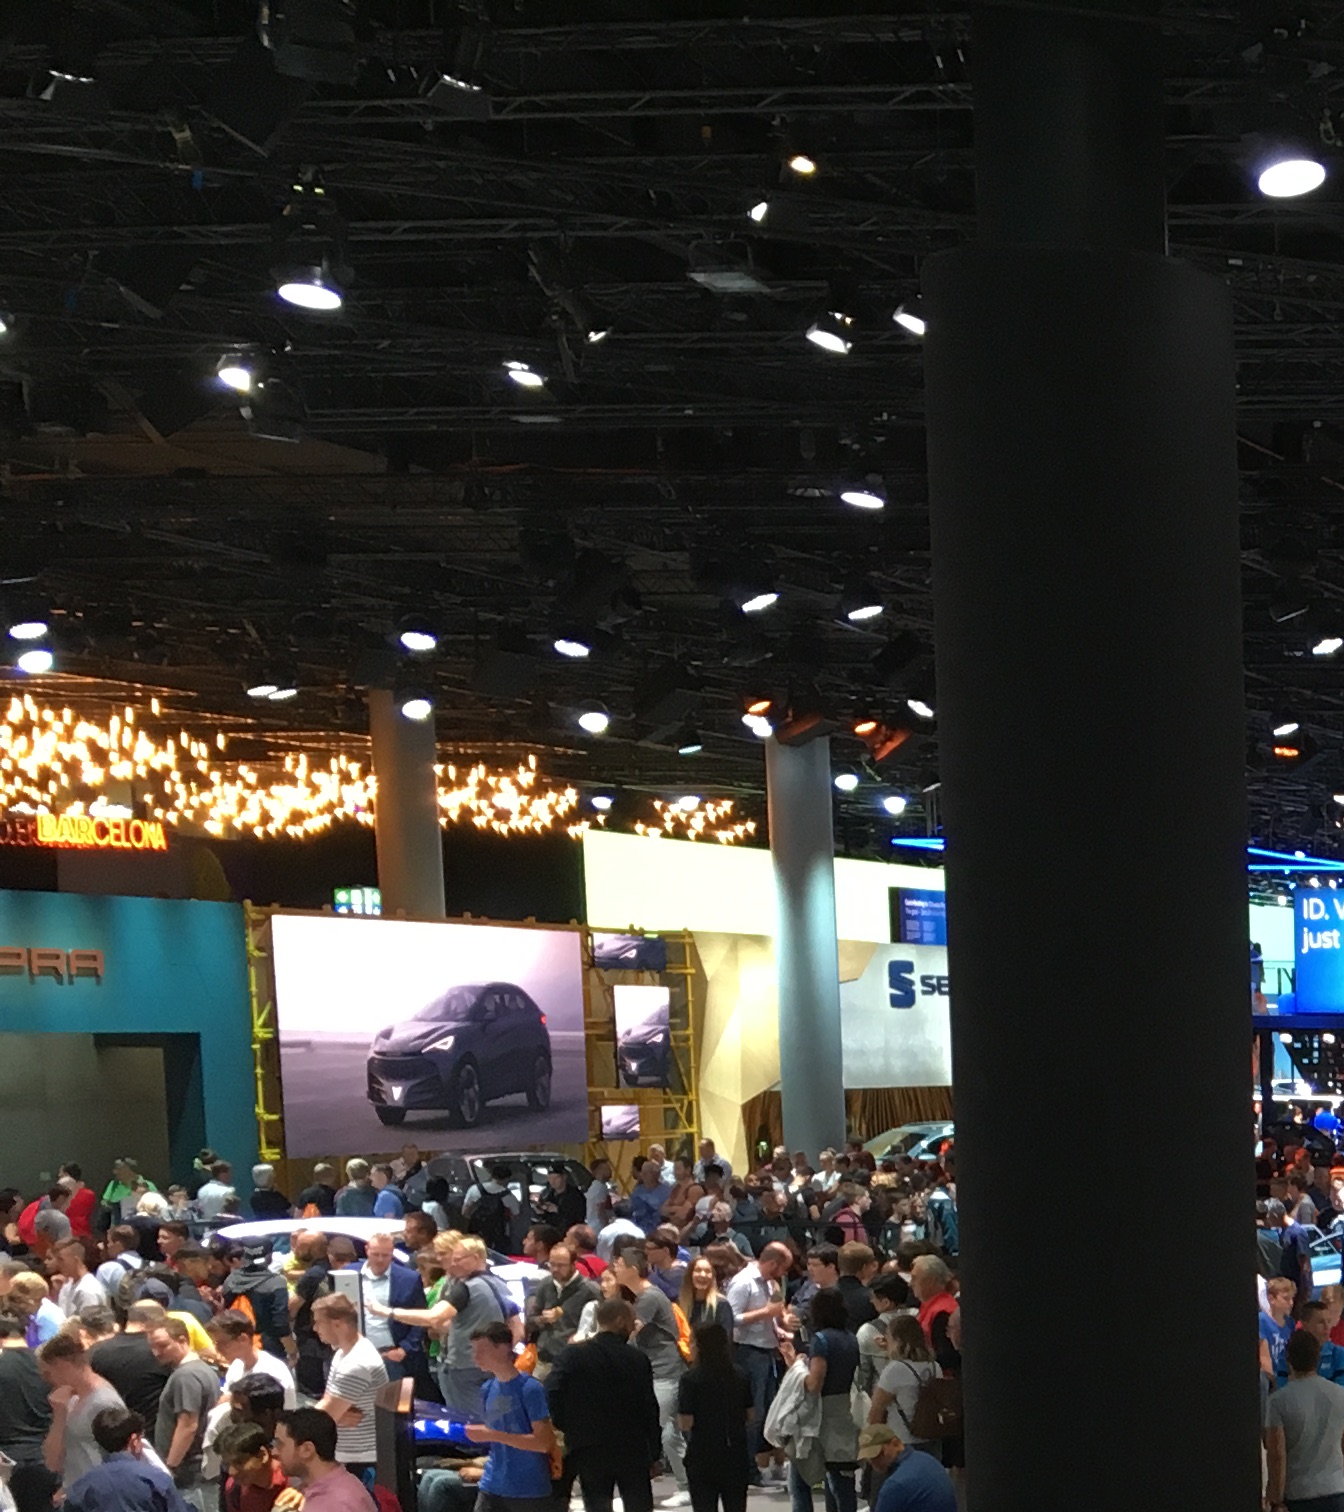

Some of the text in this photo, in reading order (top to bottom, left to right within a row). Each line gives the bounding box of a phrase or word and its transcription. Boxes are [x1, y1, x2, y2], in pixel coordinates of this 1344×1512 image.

[37, 813, 168, 850] BARCELONA
[1303, 898, 1330, 920] ID.
[1302, 927, 1340, 954] just
